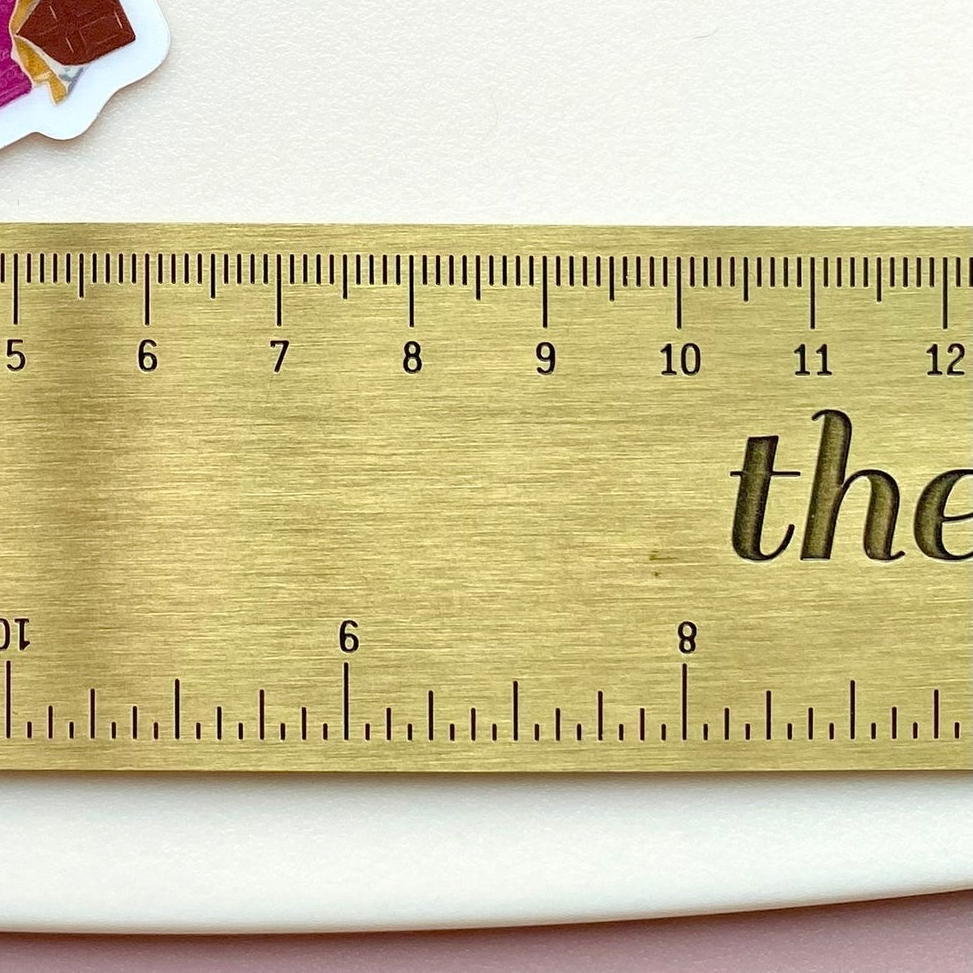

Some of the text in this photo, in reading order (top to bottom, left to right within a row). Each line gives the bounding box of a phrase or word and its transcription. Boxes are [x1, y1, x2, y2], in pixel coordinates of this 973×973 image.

[6, 338, 26, 372] 5
[138, 339, 158, 372] 6
[269, 339, 290, 373] 7
[402, 340, 423, 375] 8
[535, 341, 556, 375] 9
[660, 342, 701, 376] 10
[793, 343, 833, 376] 11
[926, 343, 966, 376] 12
[730, 409, 973, 562] the
[677, 620, 698, 654] 8
